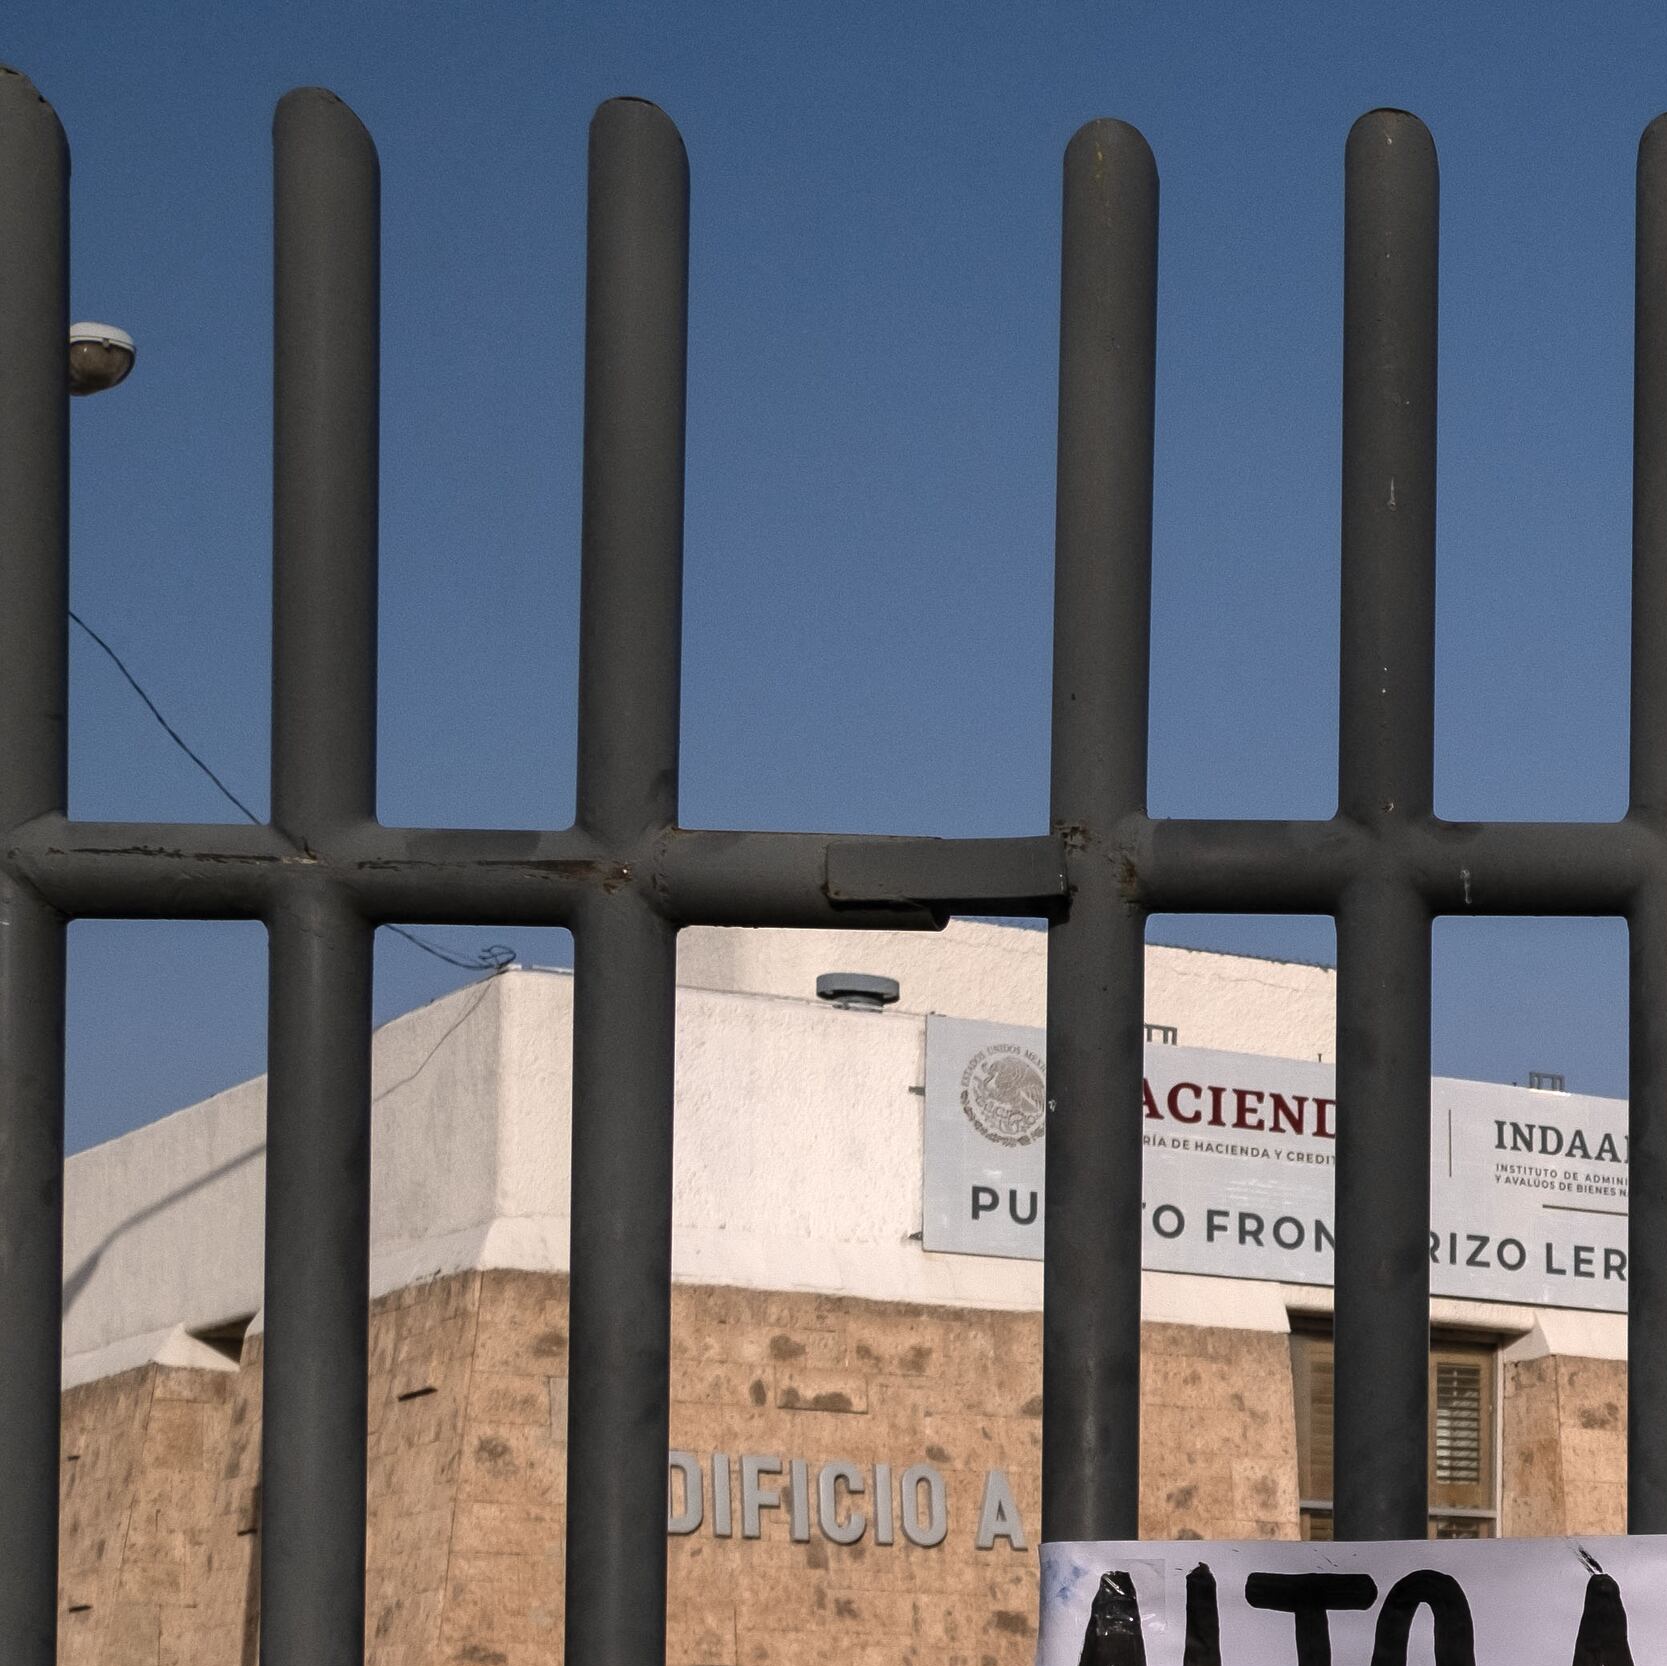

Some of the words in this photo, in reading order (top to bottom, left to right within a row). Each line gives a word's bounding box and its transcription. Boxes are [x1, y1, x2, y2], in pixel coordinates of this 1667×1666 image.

[1143, 1076, 1336, 1139] ACIEND
[1171, 1138, 1190, 1150] DE
[1194, 1141, 1270, 1159] HACIENDA
[1274, 1149, 1283, 1160] Y
[1286, 1150, 1335, 1165] CREDI
[1494, 1120, 1629, 1164] INDAA
[1496, 1163, 1558, 1179] INSTITUTO
[1563, 1171, 1579, 1181] DE
[1558, 1181, 1573, 1192] DE
[1576, 1184, 1617, 1197] BIENES
[1545, 1242, 1627, 1282] LER
[668, 1451, 948, 1547] DIFICIO
[974, 1469, 1028, 1550] A
